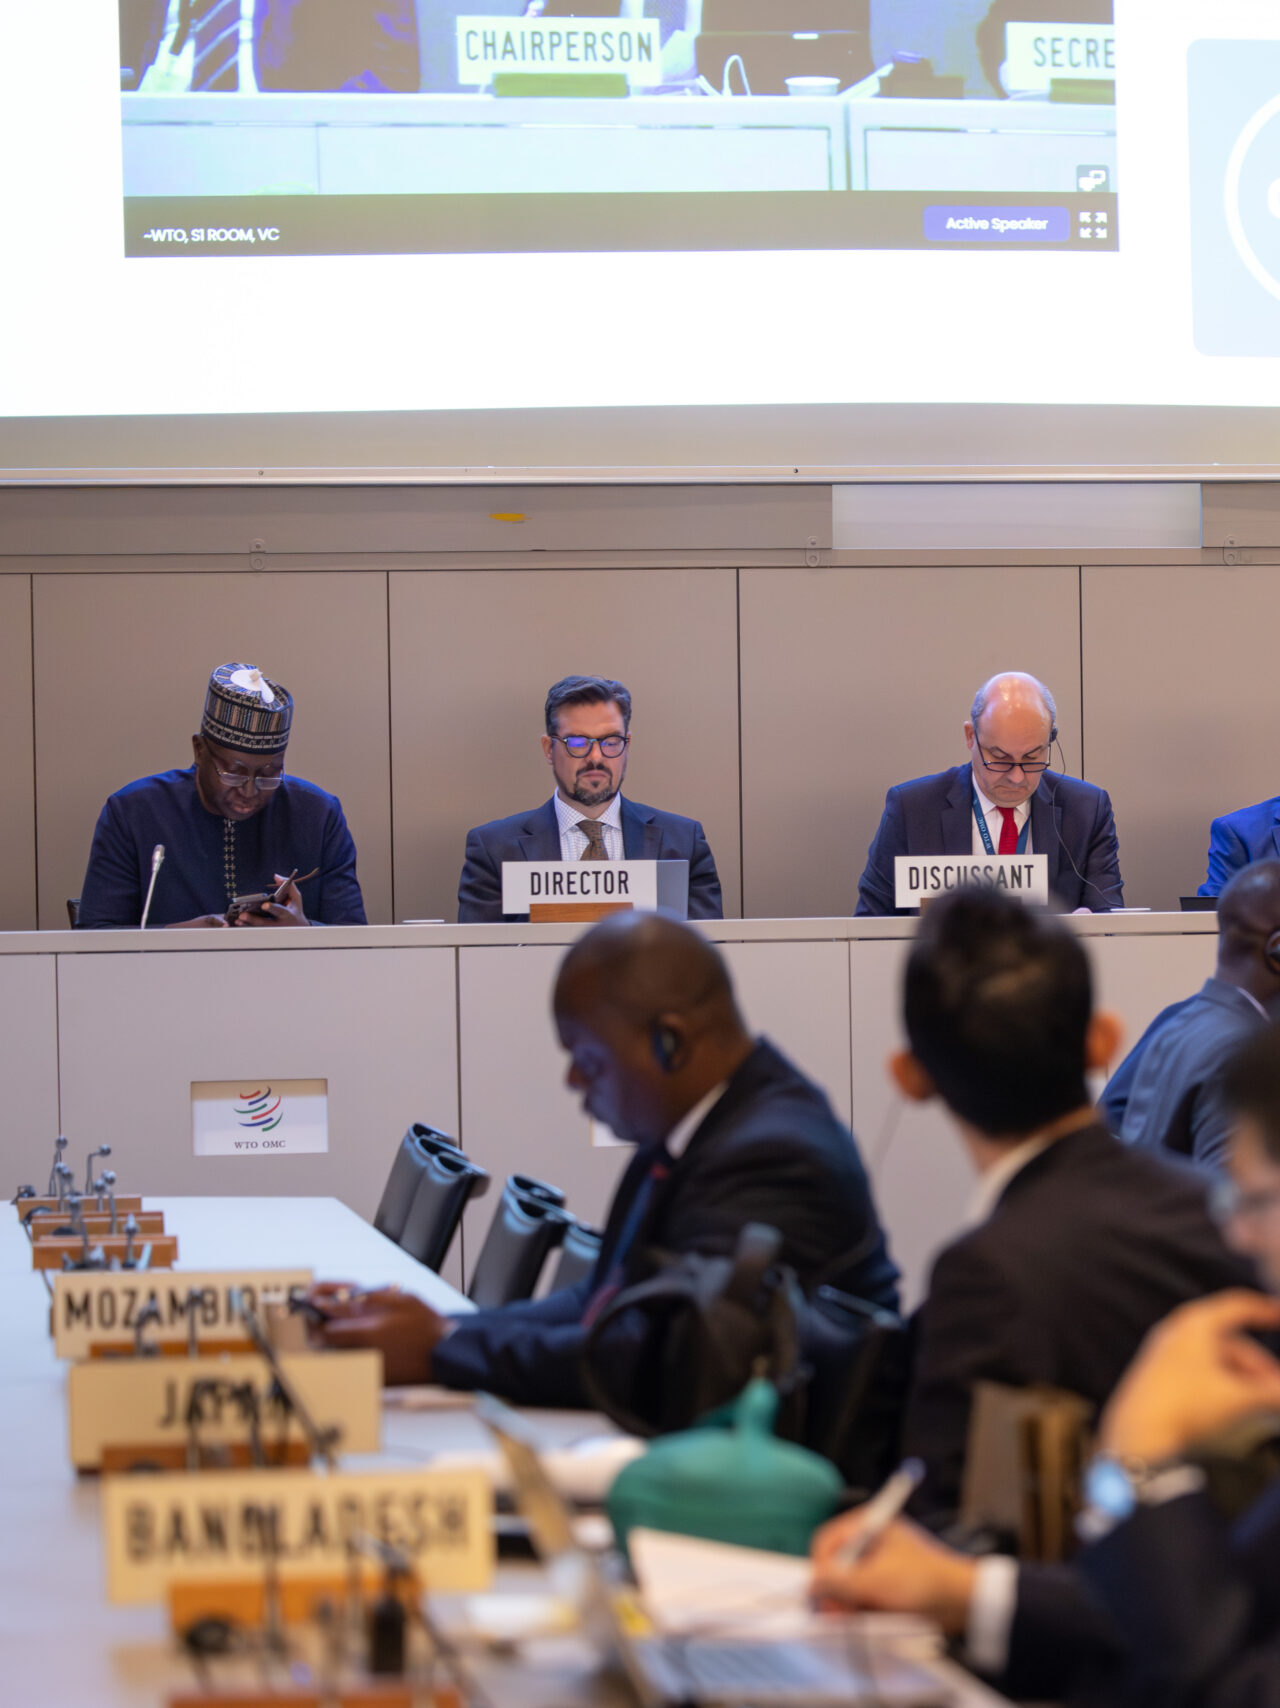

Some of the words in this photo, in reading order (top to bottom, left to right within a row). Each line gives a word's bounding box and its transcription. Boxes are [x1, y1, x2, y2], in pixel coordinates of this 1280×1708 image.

[465, 30, 653, 62] CHAIRPERSON
[1033, 37, 1115, 69] SECRE
[207, 228, 255, 243] ROOM,
[257, 227, 280, 241] VC
[945, 217, 989, 230] Active
[990, 217, 1049, 233] Speaker
[530, 870, 630, 896] DIRECTOR
[908, 864, 1034, 891] DISCUSSANT
[233, 1141, 259, 1149] WTO
[262, 1140, 287, 1149] OMC
